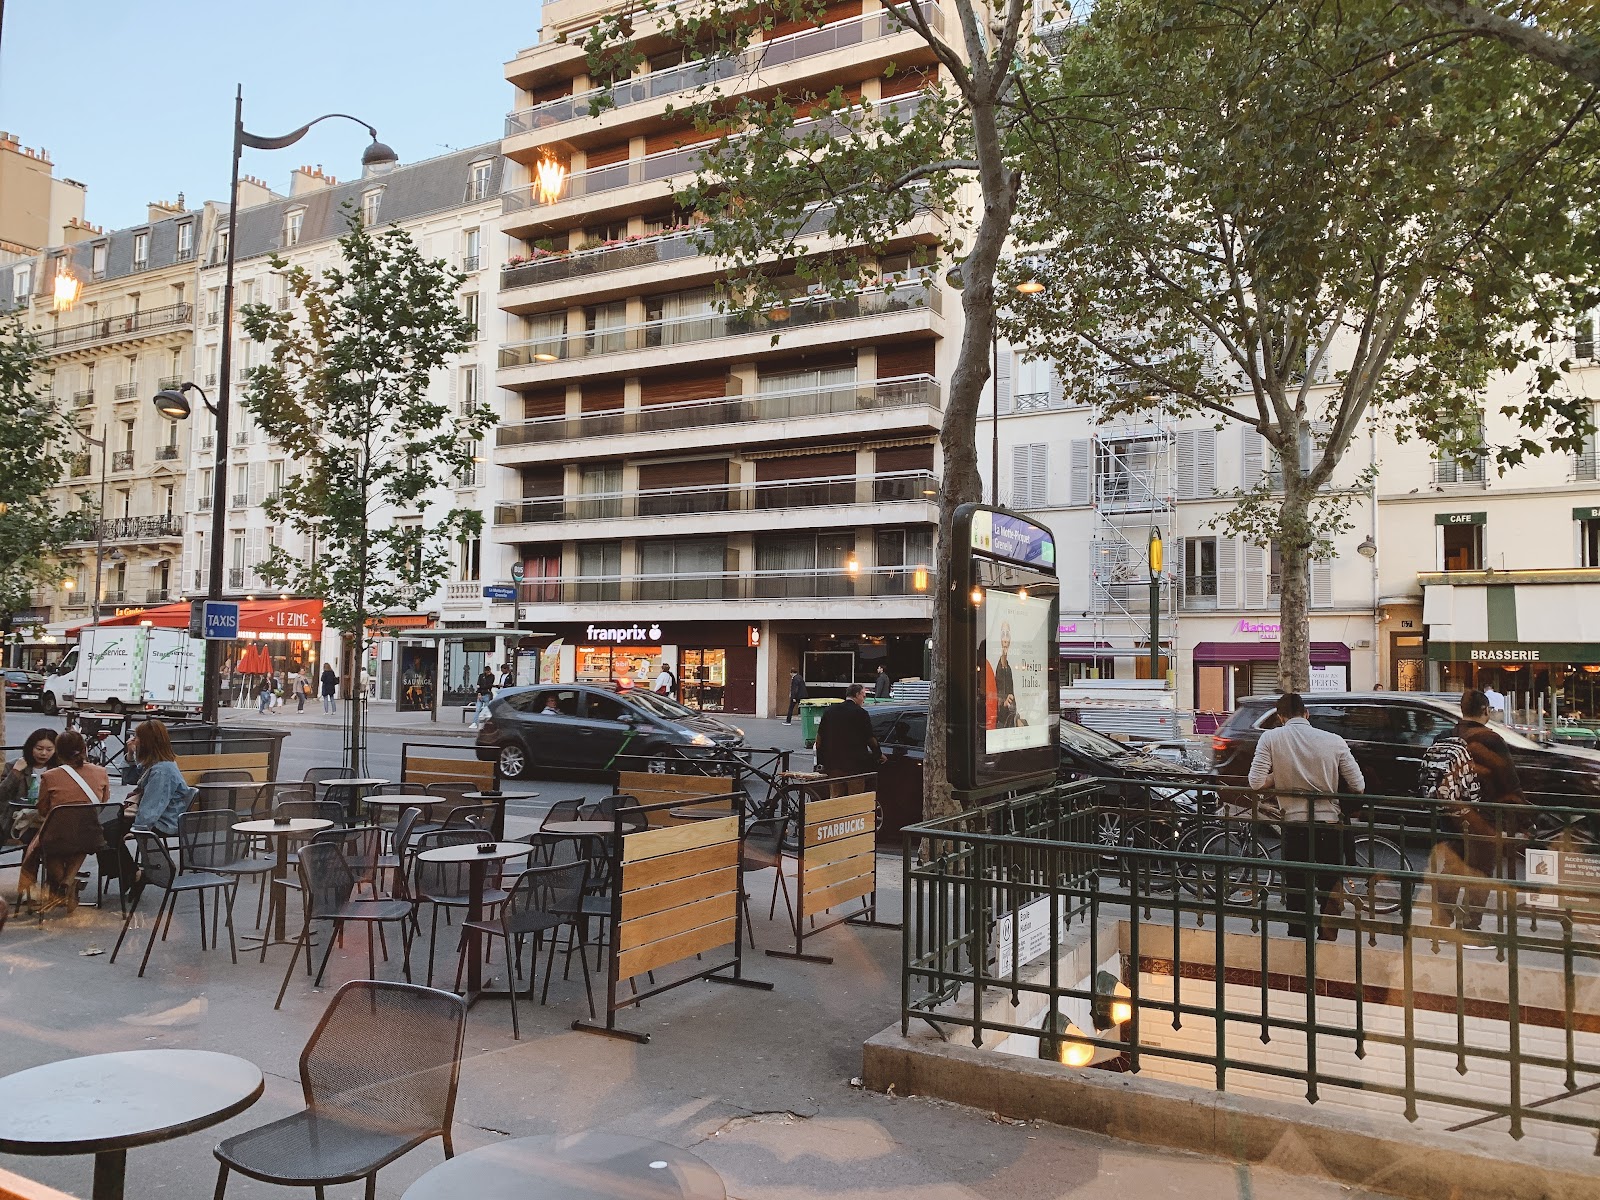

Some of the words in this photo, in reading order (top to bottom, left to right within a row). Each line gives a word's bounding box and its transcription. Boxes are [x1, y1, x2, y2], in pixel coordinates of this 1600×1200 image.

[1450, 514, 1472, 523] CAFE
[994, 523, 1000, 535] La
[1000, 525, 1031, 545] Motte-Picquet
[994, 537, 1013, 553] Grenelle
[513, 565, 524, 573] BUS
[207, 614, 236, 627] TAXIS
[276, 611, 285, 626] LE
[287, 612, 309, 627] ZINC
[587, 624, 647, 643] franprix
[1470, 649, 1540, 661] BRASSERIE
[1021, 659, 1042, 675] Design
[403, 678, 433, 686] SAUVAGE
[817, 818, 865, 841] STARBUCKS
